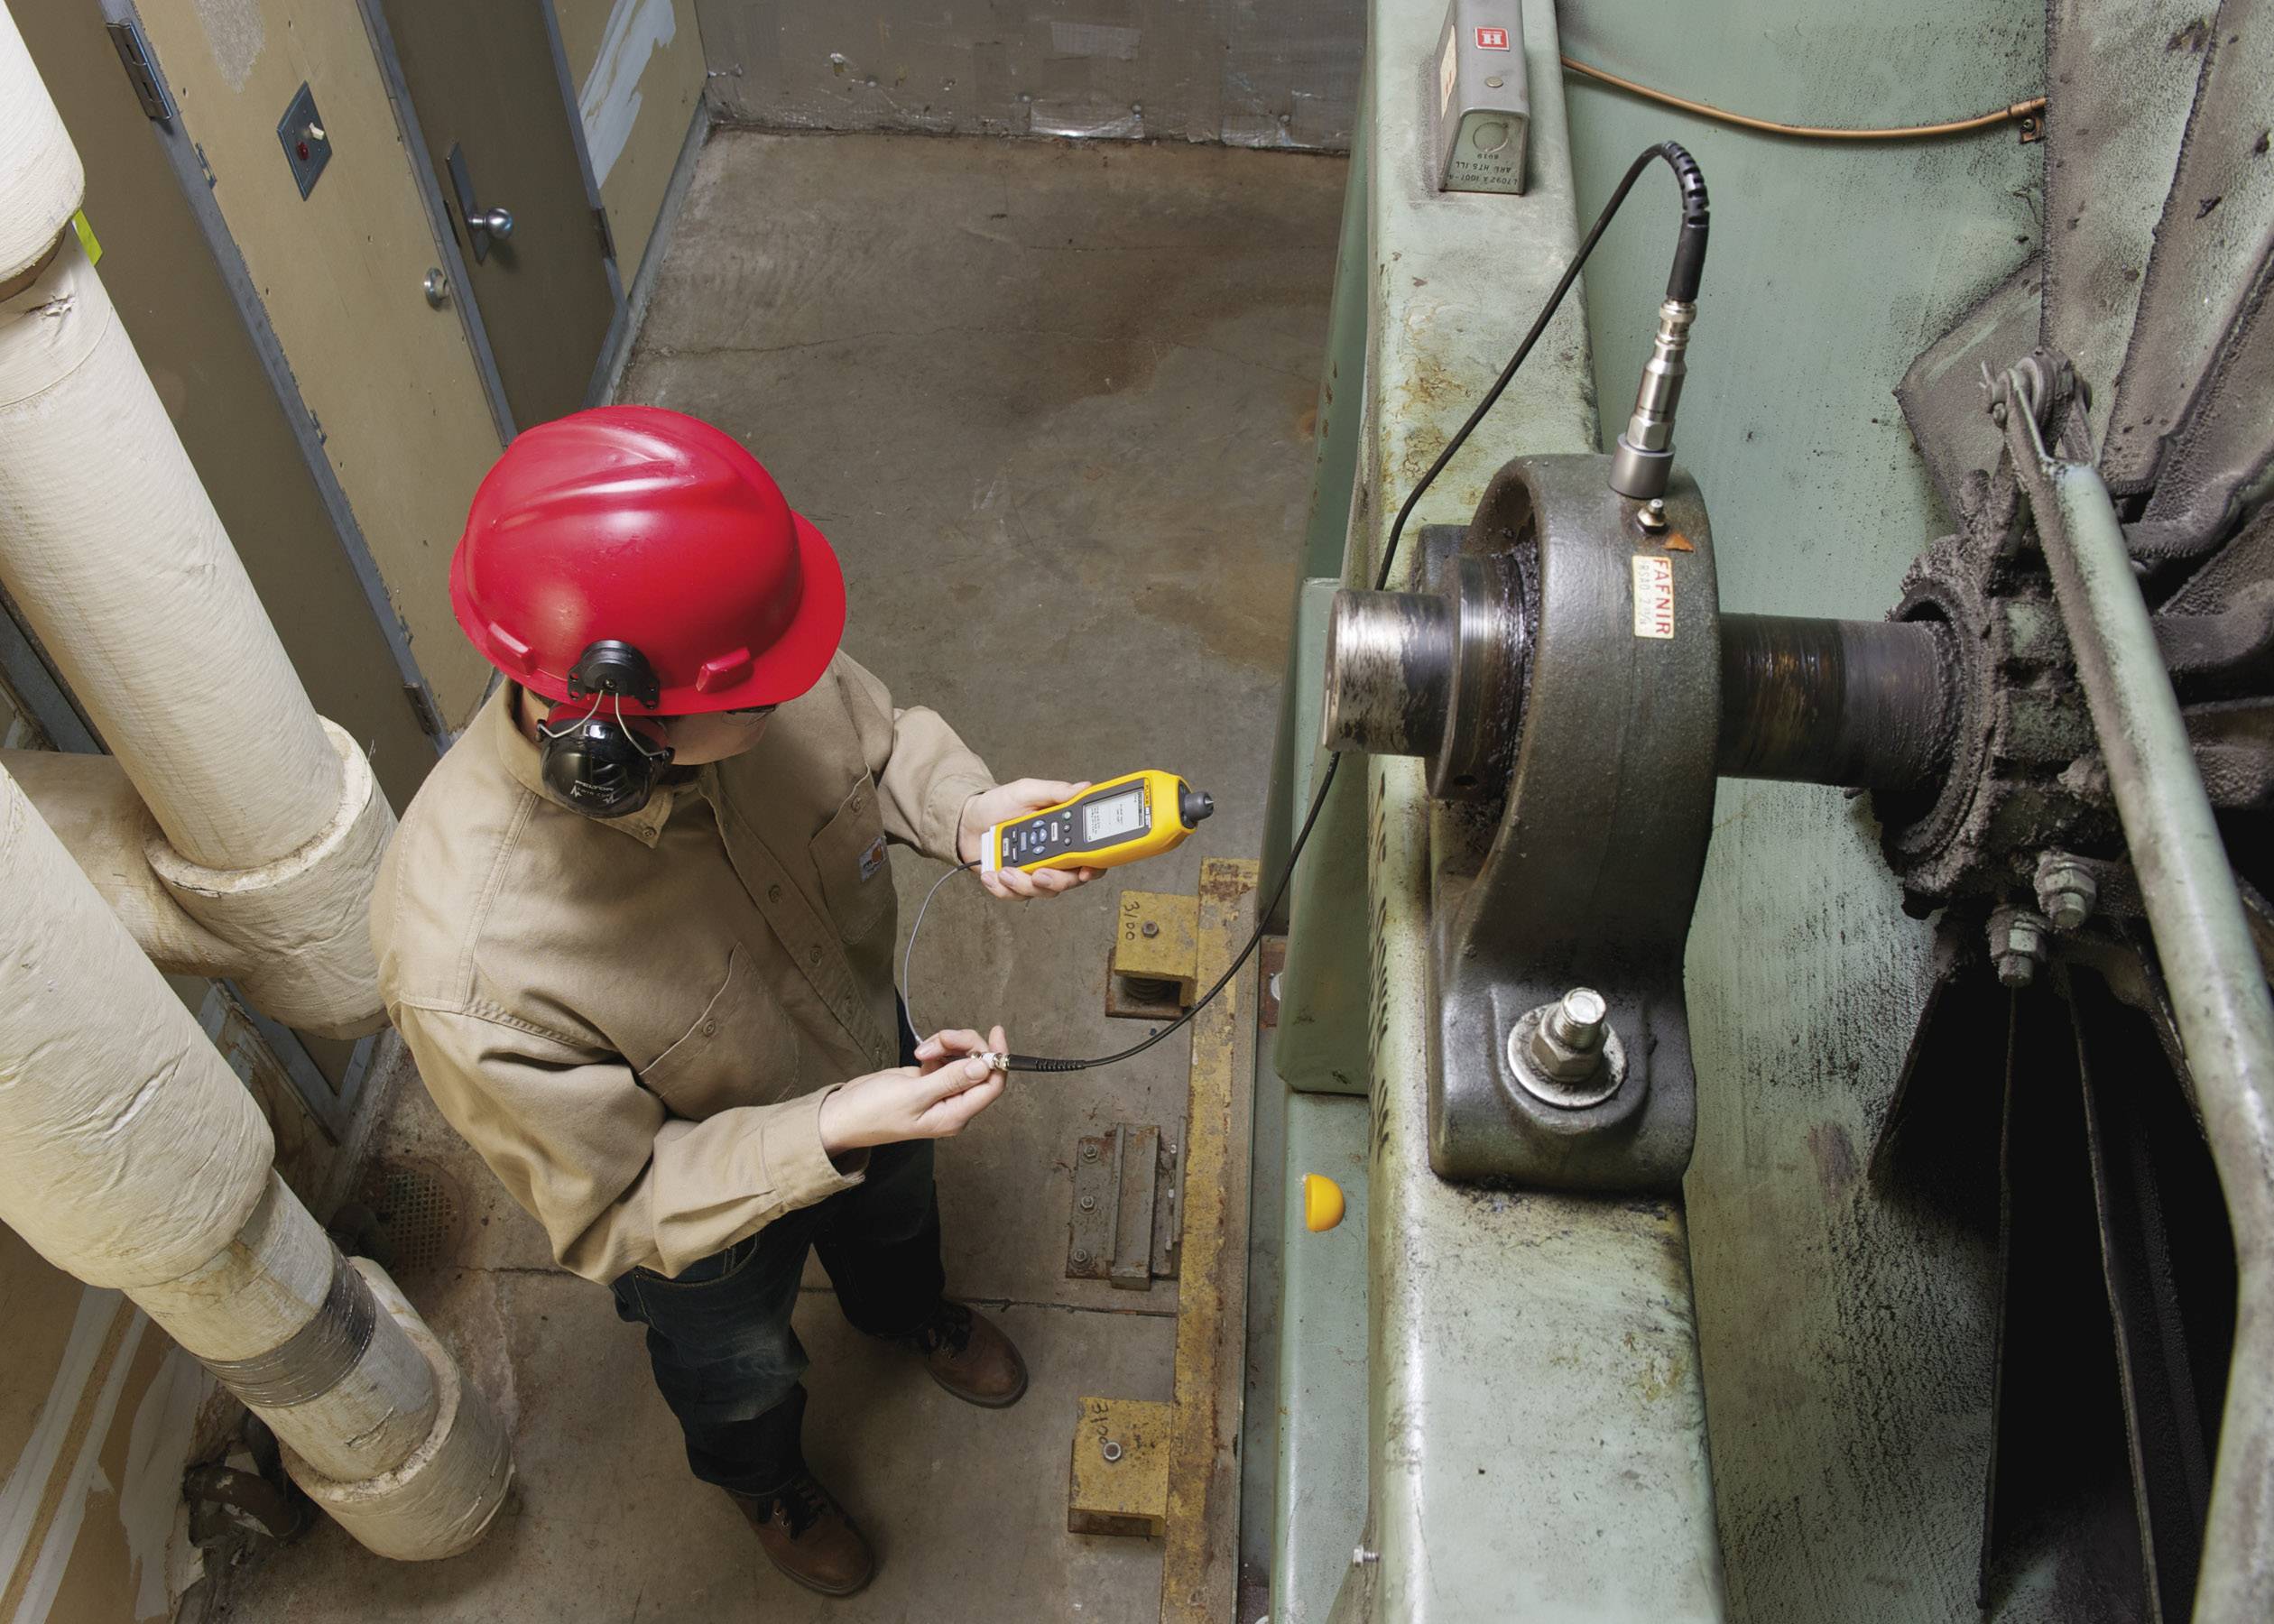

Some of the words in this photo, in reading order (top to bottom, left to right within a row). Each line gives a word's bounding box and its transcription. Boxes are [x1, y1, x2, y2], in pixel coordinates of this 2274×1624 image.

[1473, 162, 1490, 171] HTS
[1653, 558, 1671, 634] FAFNIR
[575, 780, 615, 791] PELTOR
[1123, 900, 1140, 941] 3100
